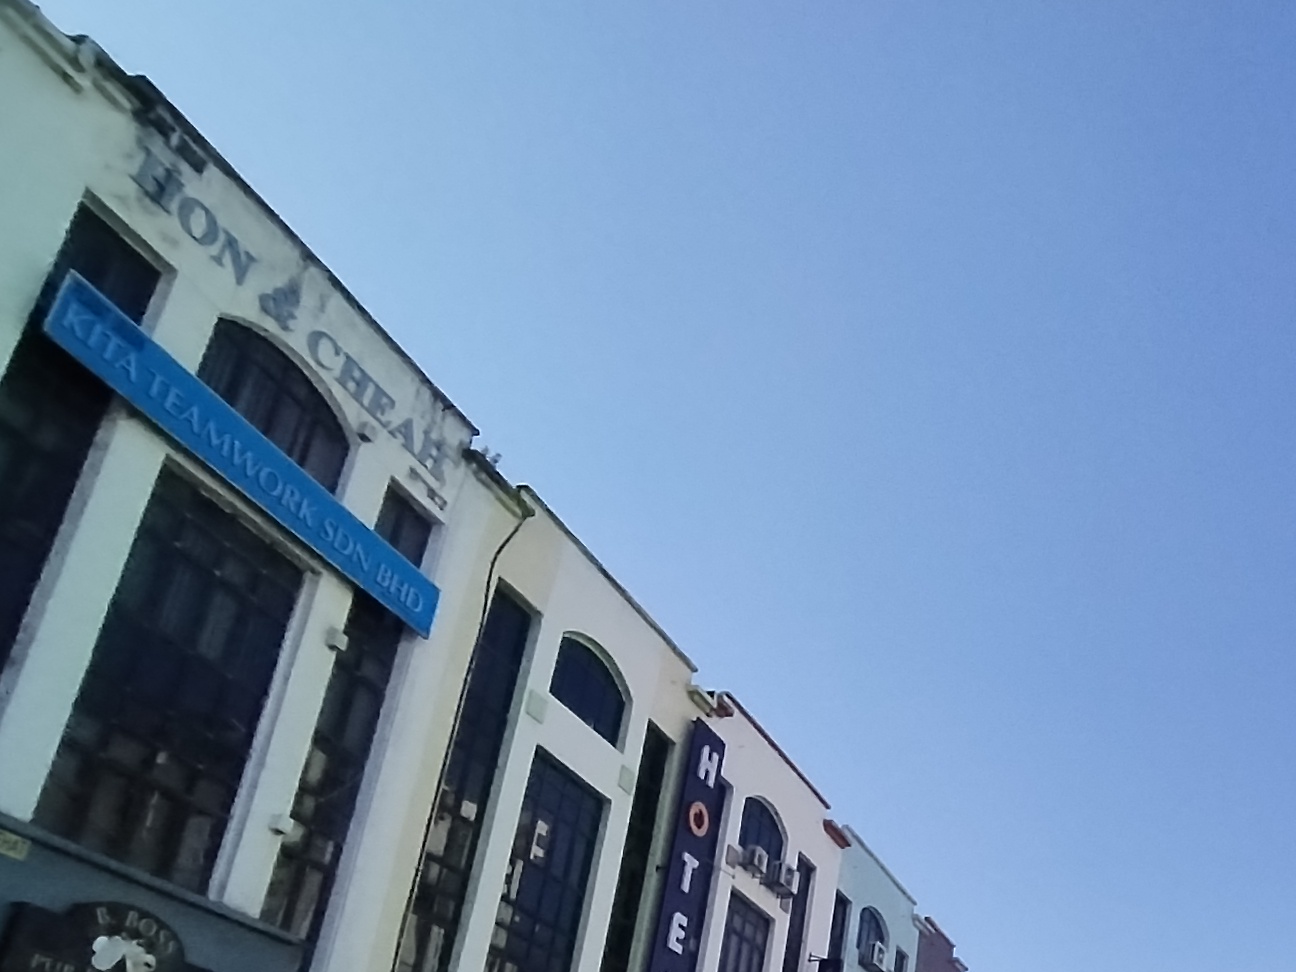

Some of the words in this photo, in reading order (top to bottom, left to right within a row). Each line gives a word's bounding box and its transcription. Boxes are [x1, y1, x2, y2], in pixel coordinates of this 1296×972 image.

[61, 301, 138, 383] KITA
[146, 366, 318, 529] TEAMWORK
[319, 517, 373, 573] SDN
[375, 563, 424, 613] BHD
